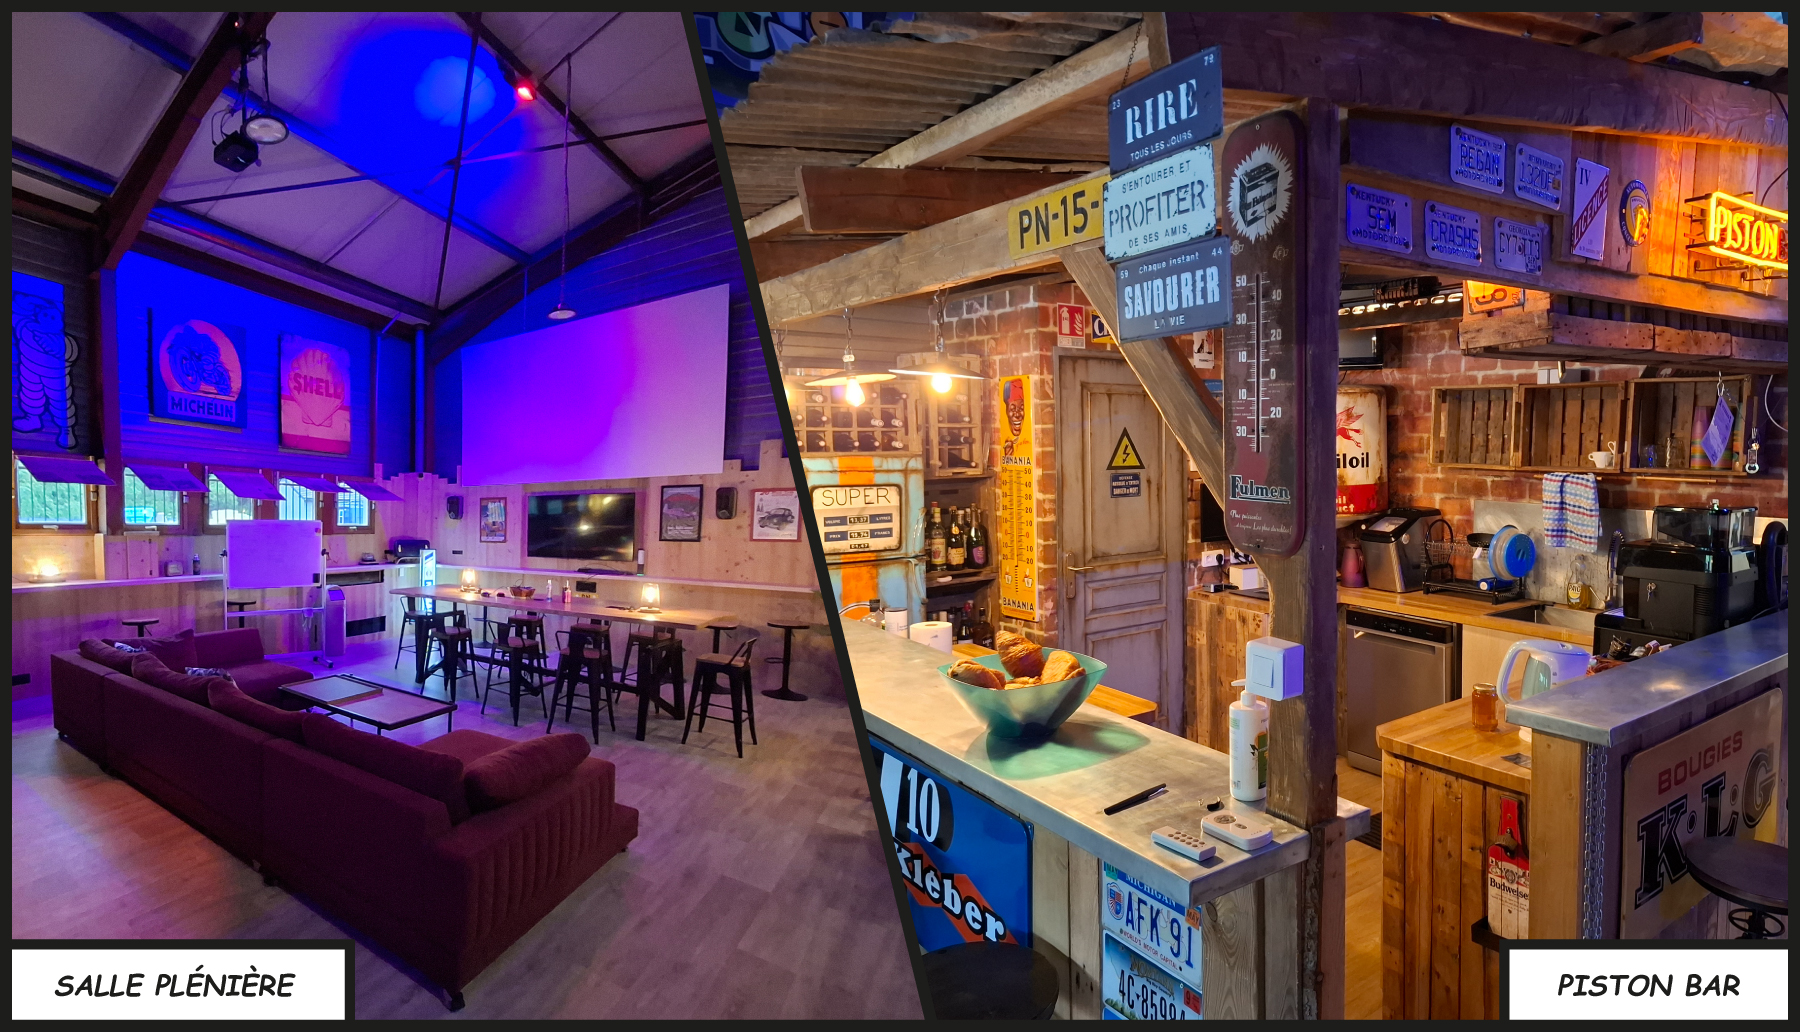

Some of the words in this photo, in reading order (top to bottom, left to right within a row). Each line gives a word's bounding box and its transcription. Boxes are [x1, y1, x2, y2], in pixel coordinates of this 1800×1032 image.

[1204, 54, 1214, 66] 79
[1112, 99, 1121, 110] 23
[1125, 78, 1198, 144] RIRE
[1130, 147, 1149, 161] TOUS
[1151, 141, 1165, 154] LES
[1166, 130, 1193, 147] JOURS
[1460, 143, 1500, 176] REGAN
[1122, 165, 1175, 193] S'ENTOURER
[1179, 160, 1191, 173] ET
[1579, 167, 1591, 186] IV
[1356, 190, 1395, 207] KENTUCKY
[1109, 179, 1206, 238] PROFITER
[1574, 177, 1608, 246] LICENCE
[1368, 205, 1397, 233] SEM
[1129, 238, 1140, 249] DE
[1143, 233, 1159, 245] SES
[1165, 223, 1188, 238] AMIS
[1431, 219, 1479, 250] CRASHS
[1508, 225, 1531, 236] GEORGIA
[1714, 205, 1779, 259] PISTON
[1120, 269, 1129, 279] 59
[1169, 251, 1199, 266] instant
[1211, 247, 1223, 257] 44
[1235, 275, 1247, 287] 50
[1124, 266, 1220, 320] SAVOURER
[1272, 289, 1282, 300] 40
[1169, 315, 1186, 327] VIE
[1235, 313, 1247, 325] 30
[1270, 329, 1282, 341] 20
[1238, 351, 1247, 362] 10
[1270, 368, 1276, 380] 0
[293, 372, 342, 400] SHELL
[1238, 389, 1247, 400] 10
[171, 396, 234, 417] MICHELIN
[1270, 406, 1282, 418] 20
[1235, 426, 1247, 437] 30
[1002, 456, 1032, 466] BANANIA
[822, 487, 891, 507] SUPER
[1229, 475, 1291, 500] Fulmen
[1003, 597, 1035, 611] BANANIA
[1658, 730, 1743, 795] BOUGIES
[1186, 909, 1200, 925] MAY
[1122, 931, 1141, 946] WORLD'S
[1143, 942, 1158, 957] MOTOR
[1160, 953, 1178, 970] CAPITAL
